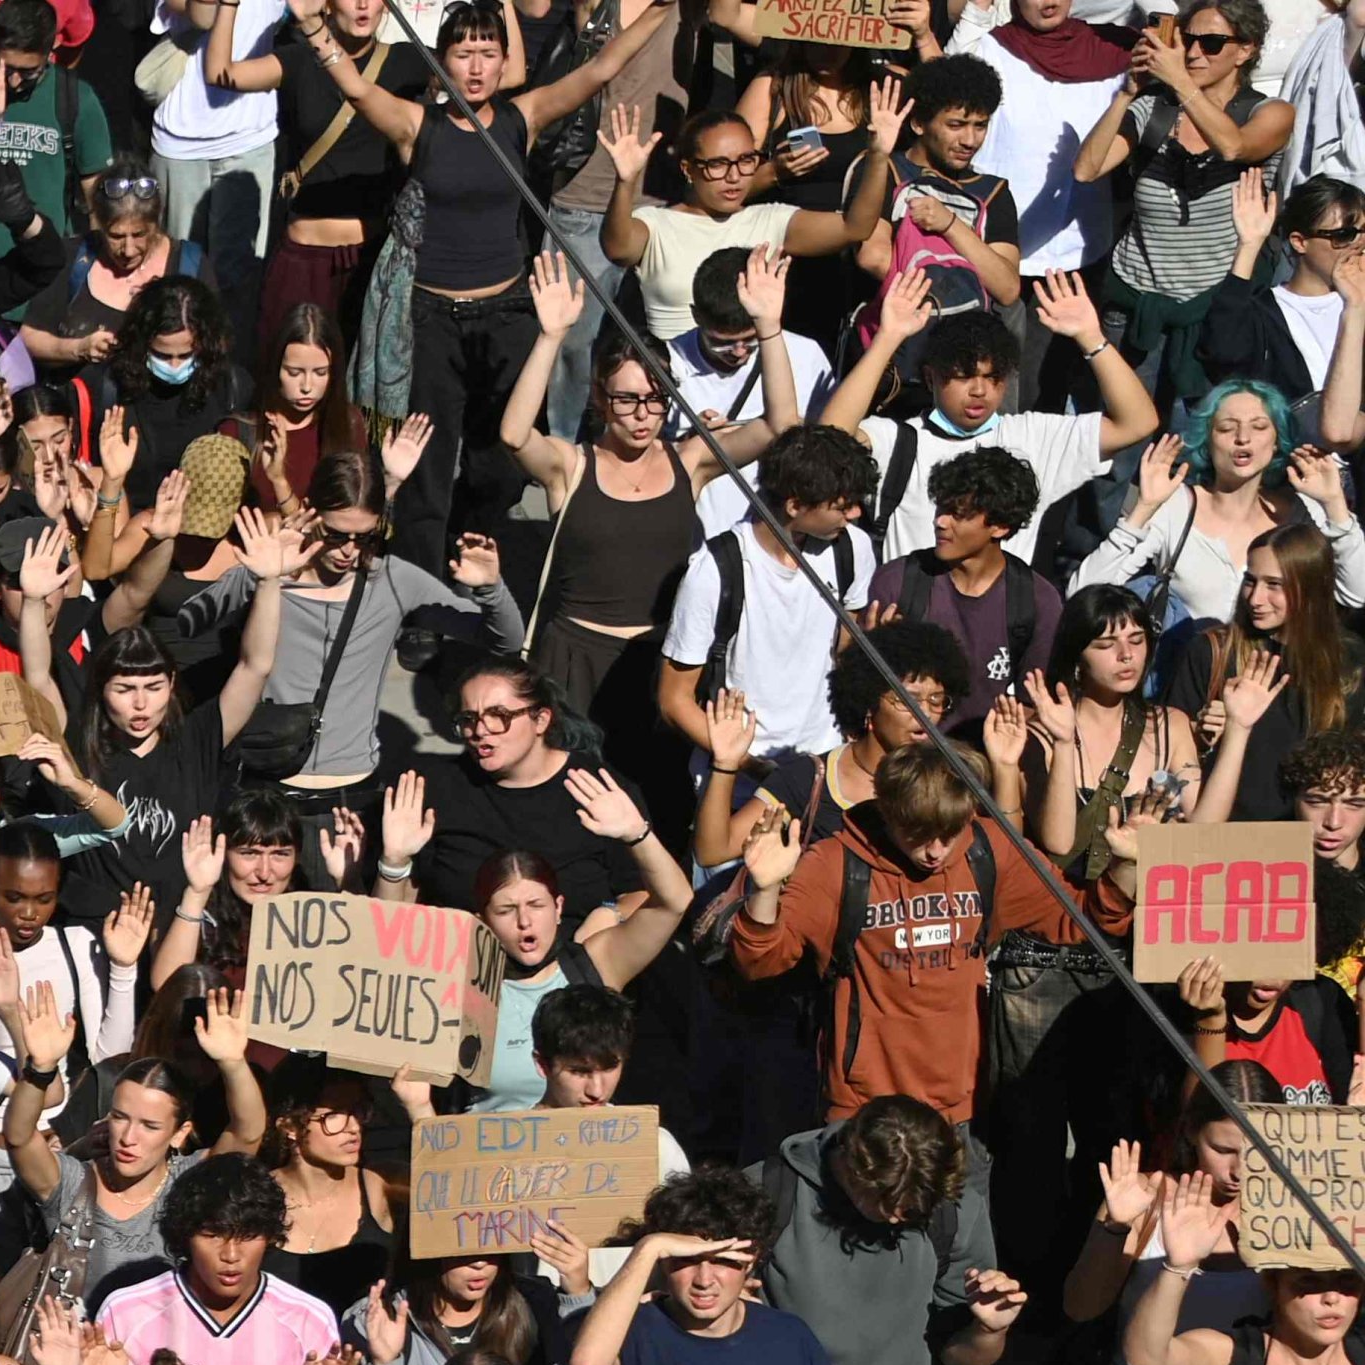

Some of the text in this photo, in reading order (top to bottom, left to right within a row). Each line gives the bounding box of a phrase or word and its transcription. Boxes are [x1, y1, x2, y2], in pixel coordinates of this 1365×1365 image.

[782, 12, 885, 44] SACRIFIER
[1143, 860, 1309, 945] ACAB
[265, 897, 475, 974] NOS VOIX
[251, 960, 316, 1032] NOS
[420, 1120, 461, 1152] NOS
[477, 1116, 550, 1152] EDT
[416, 1162, 620, 1220] QUE LE DE
[1249, 1214, 1313, 1251] SON
